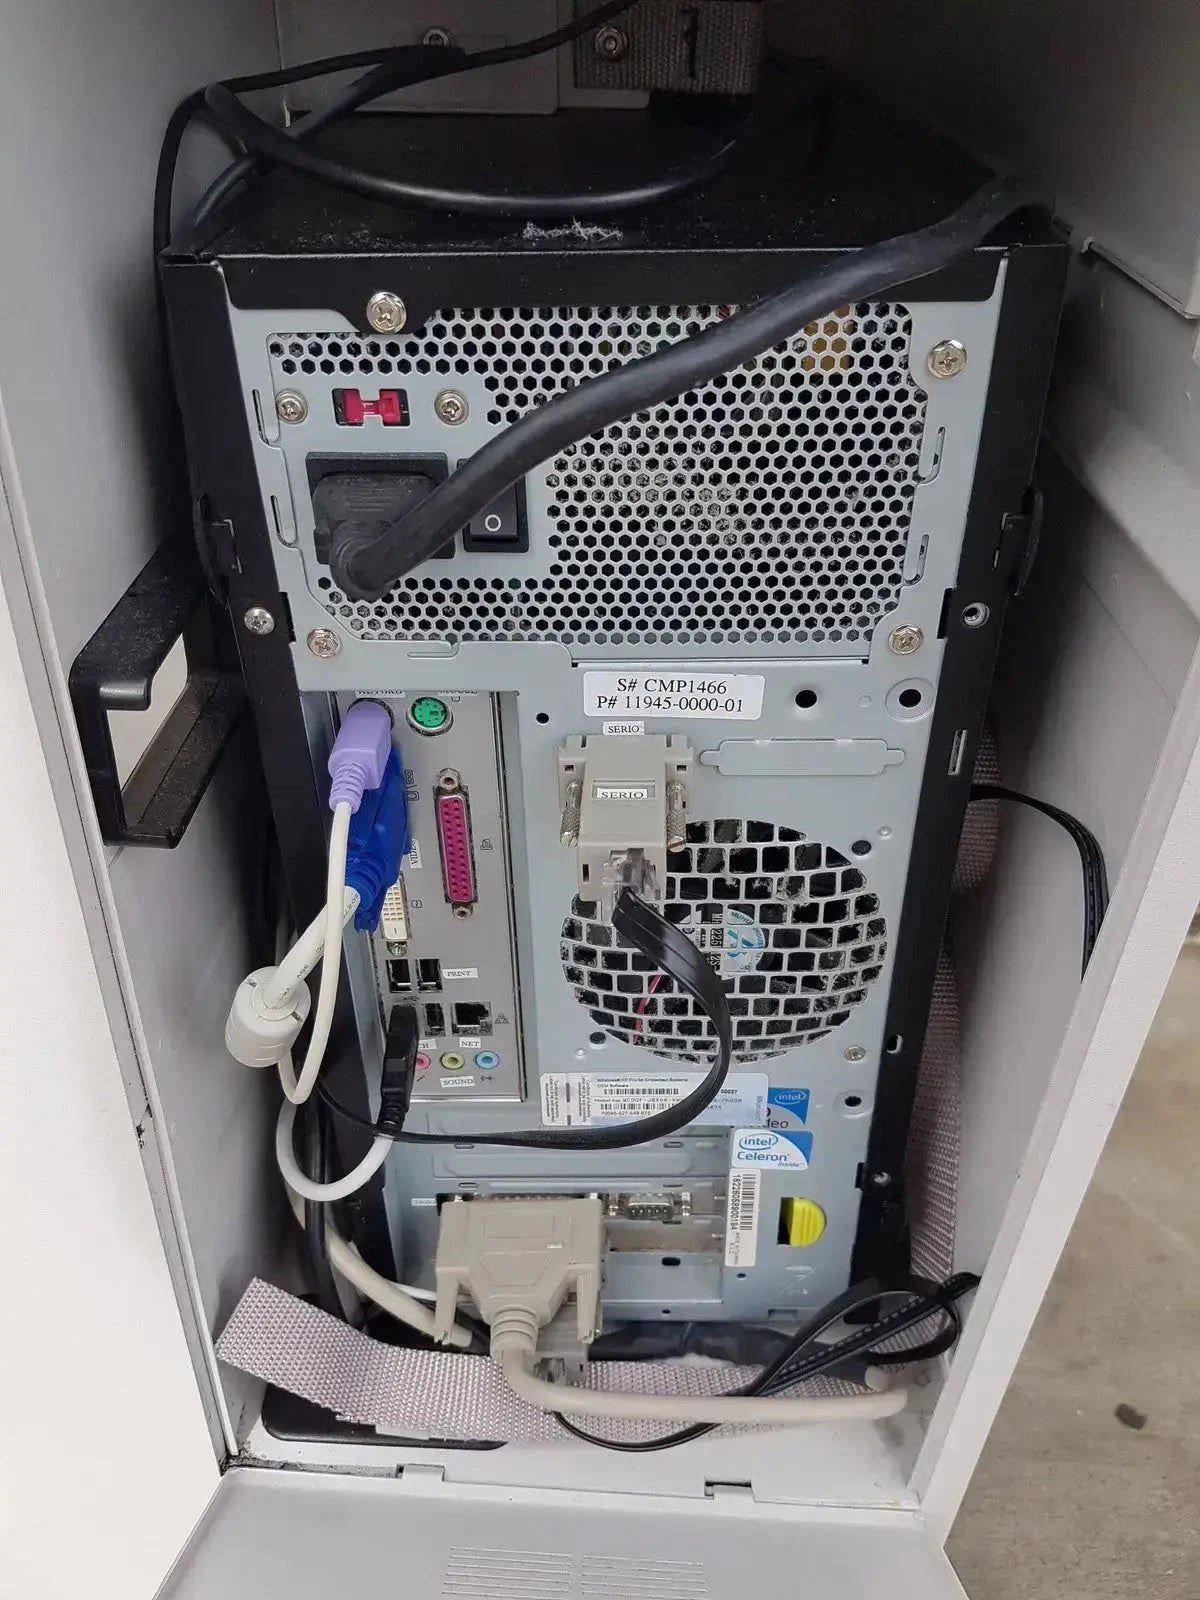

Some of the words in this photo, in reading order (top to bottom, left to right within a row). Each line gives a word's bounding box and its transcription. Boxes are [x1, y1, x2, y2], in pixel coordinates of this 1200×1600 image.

[617, 678, 638, 692] S#
[644, 678, 727, 695] CMP1466
[596, 695, 618, 709] P#
[625, 696, 743, 713] 11945-0000-01
[608, 725, 640, 734] SERIO
[600, 791, 644, 799] SERIO
[743, 1136, 773, 1146] intel
